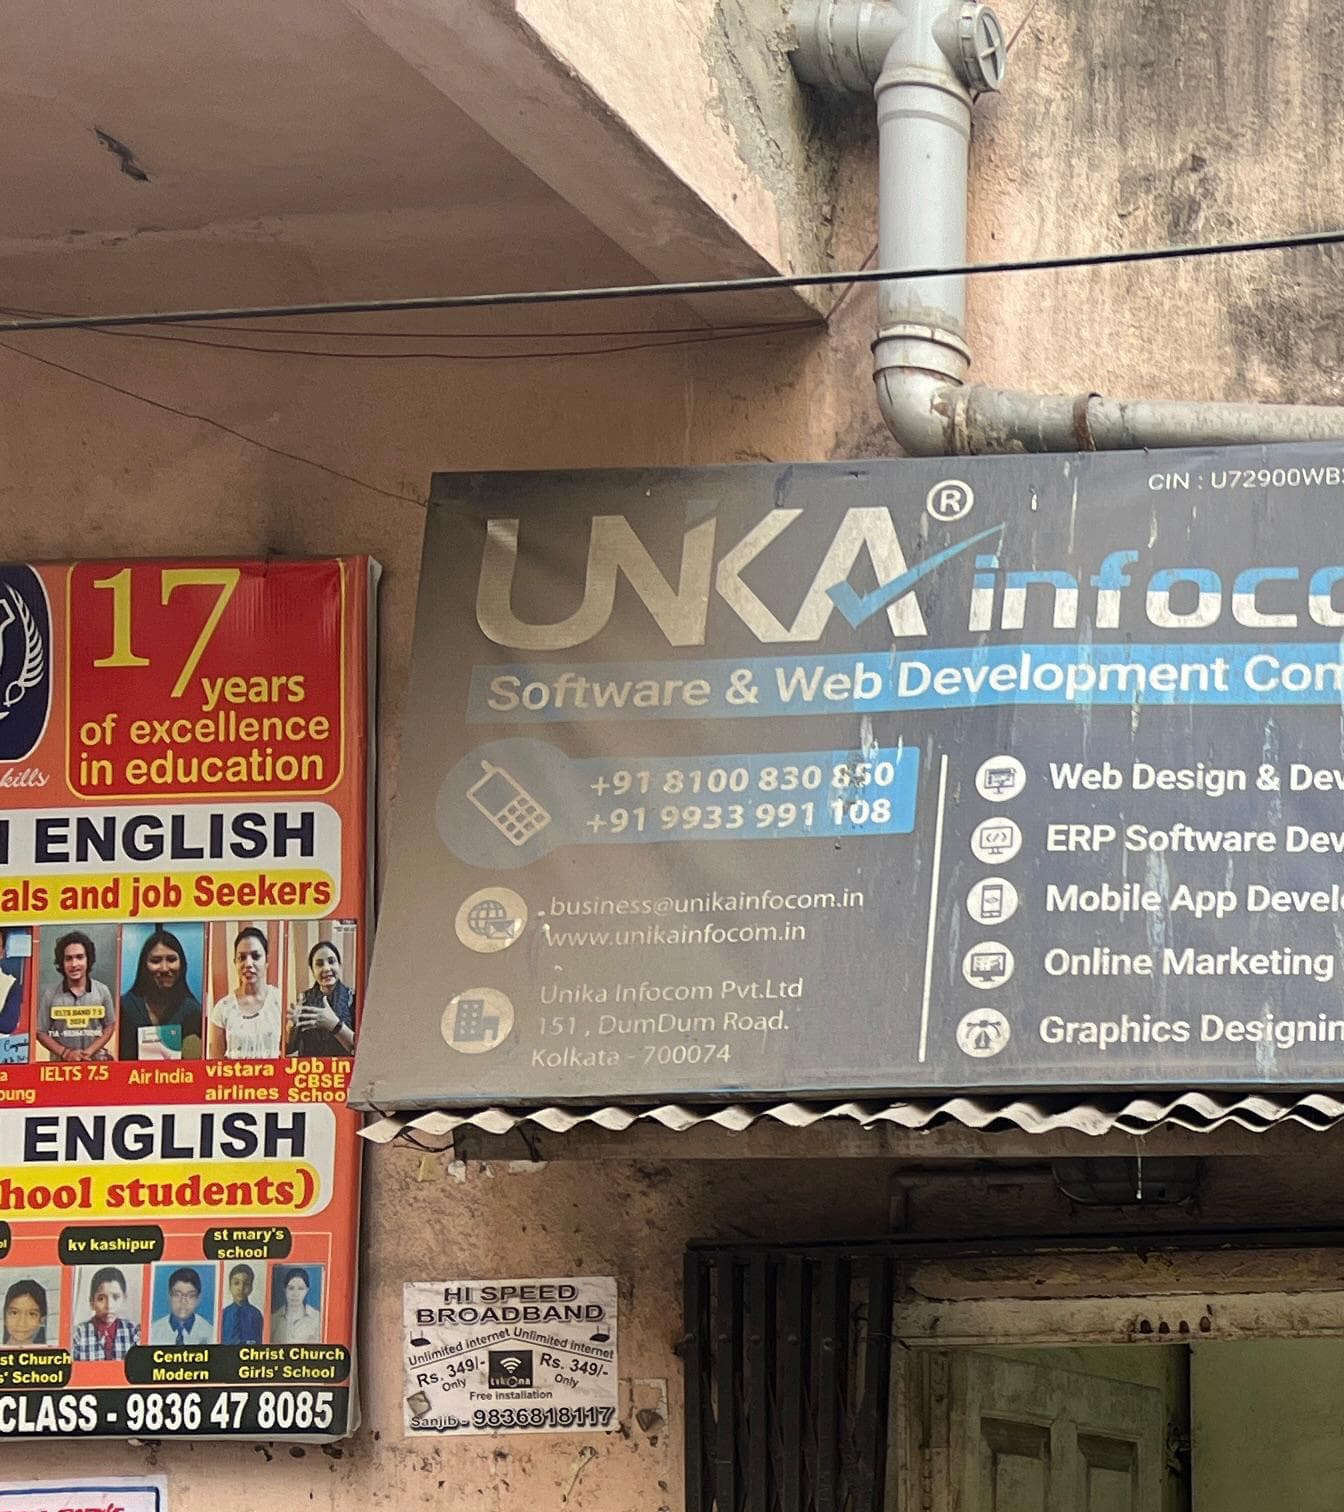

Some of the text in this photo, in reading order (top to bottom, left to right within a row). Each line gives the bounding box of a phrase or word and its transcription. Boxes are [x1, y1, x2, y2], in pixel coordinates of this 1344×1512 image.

[1148, 471, 1189, 491] CIN
[93, 568, 240, 698] 17
[202, 675, 305, 712] years
[487, 671, 711, 712] Software
[725, 668, 759, 704] &
[776, 663, 882, 703] Web
[897, 653, 1230, 702] Development
[79, 711, 330, 746] of excellence
[79, 748, 323, 786] in education
[1049, 764, 1123, 791] Web
[1132, 765, 1247, 797] Design
[1256, 766, 1280, 791] &
[34, 811, 315, 864] ENGLISH
[1046, 825, 1116, 852] ERP
[1124, 825, 1277, 853] Software
[60, 874, 331, 916] and job Seekers
[550, 888, 864, 918] business@unikainfocom.in
[1045, 885, 1161, 913] Mobile
[1169, 886, 1237, 919] App
[545, 922, 806, 947] www.unikainfocom.in
[1039, 1015, 1190, 1051] Graphics
[40, 1066, 109, 1081] IELTS 7.5
[129, 1069, 193, 1084] Air India
[68, 1237, 156, 1253] kv kashipur
[444, 1285, 579, 1303] HI SPEED
[417, 1305, 606, 1324] BROADBAND
[0, 1391, 333, 1432] CLASS 9836 47 8085
[473, 1407, 616, 1427] 9836818117
